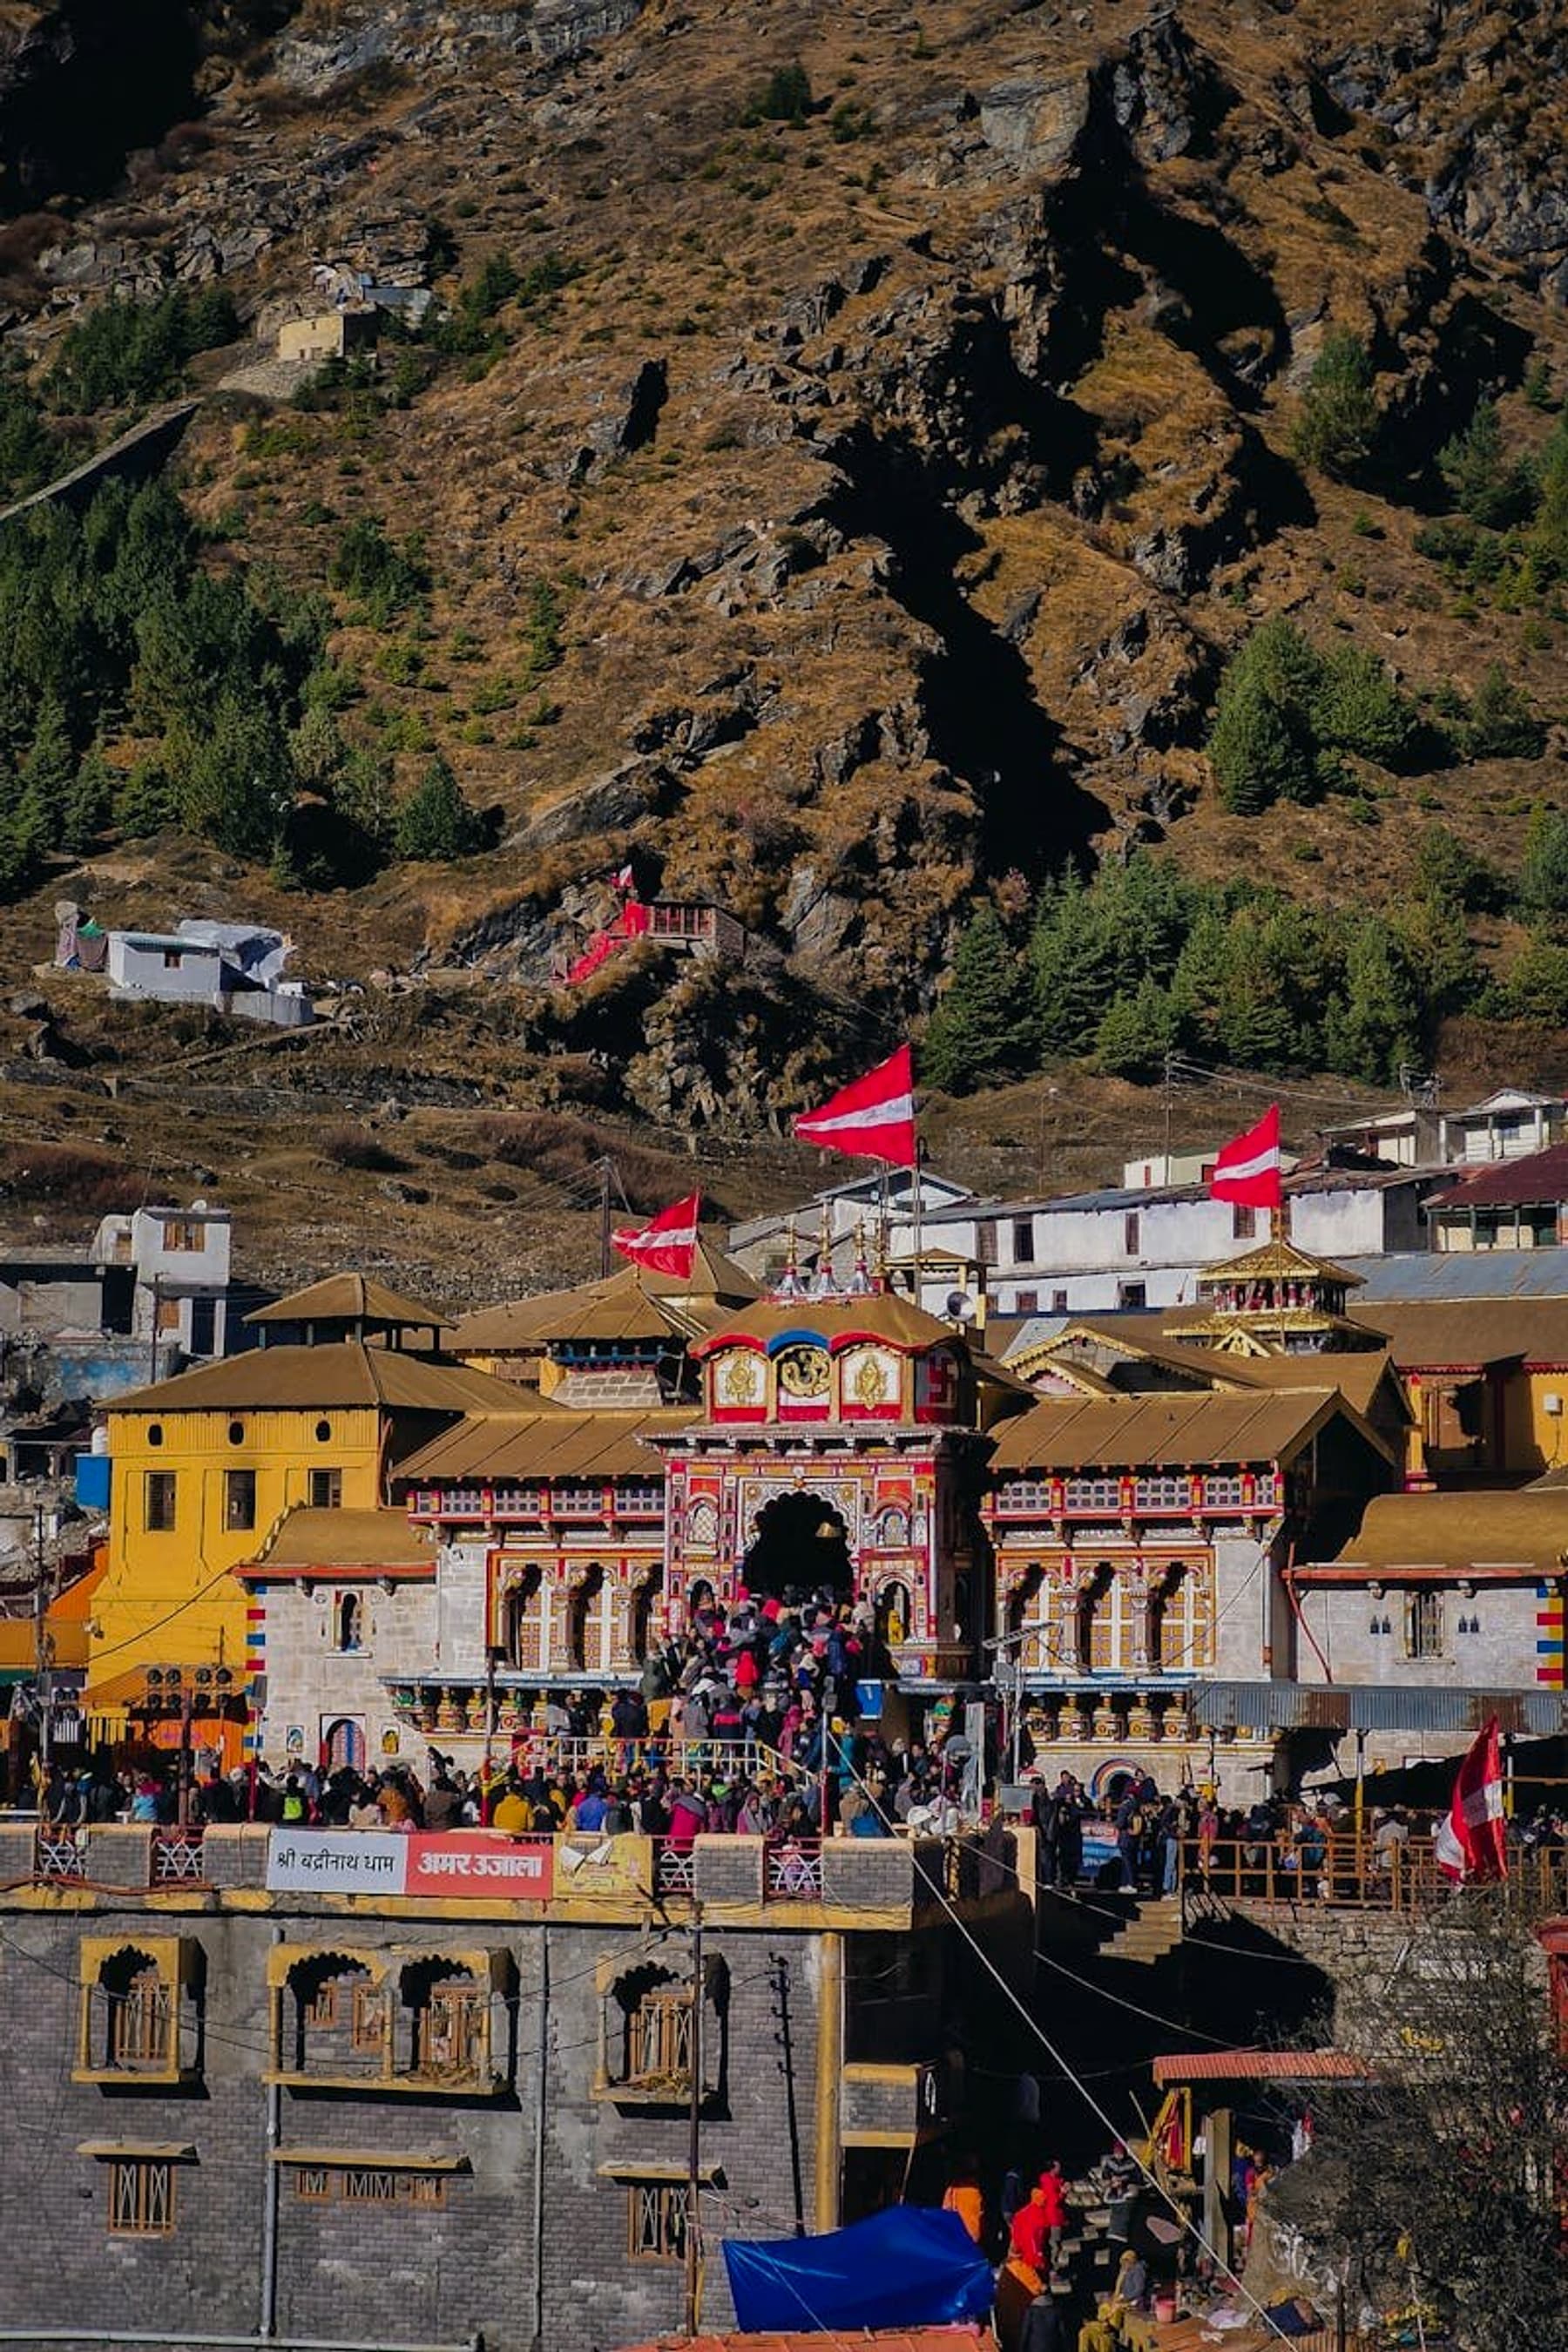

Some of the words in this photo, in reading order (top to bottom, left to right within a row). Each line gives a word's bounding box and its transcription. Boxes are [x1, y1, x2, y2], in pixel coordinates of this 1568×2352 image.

[277, 1848, 295, 1869] श्री
[364, 1855, 395, 1872] धाम
[417, 1851, 471, 1876] अमर
[472, 1854, 543, 1878] उजाला
